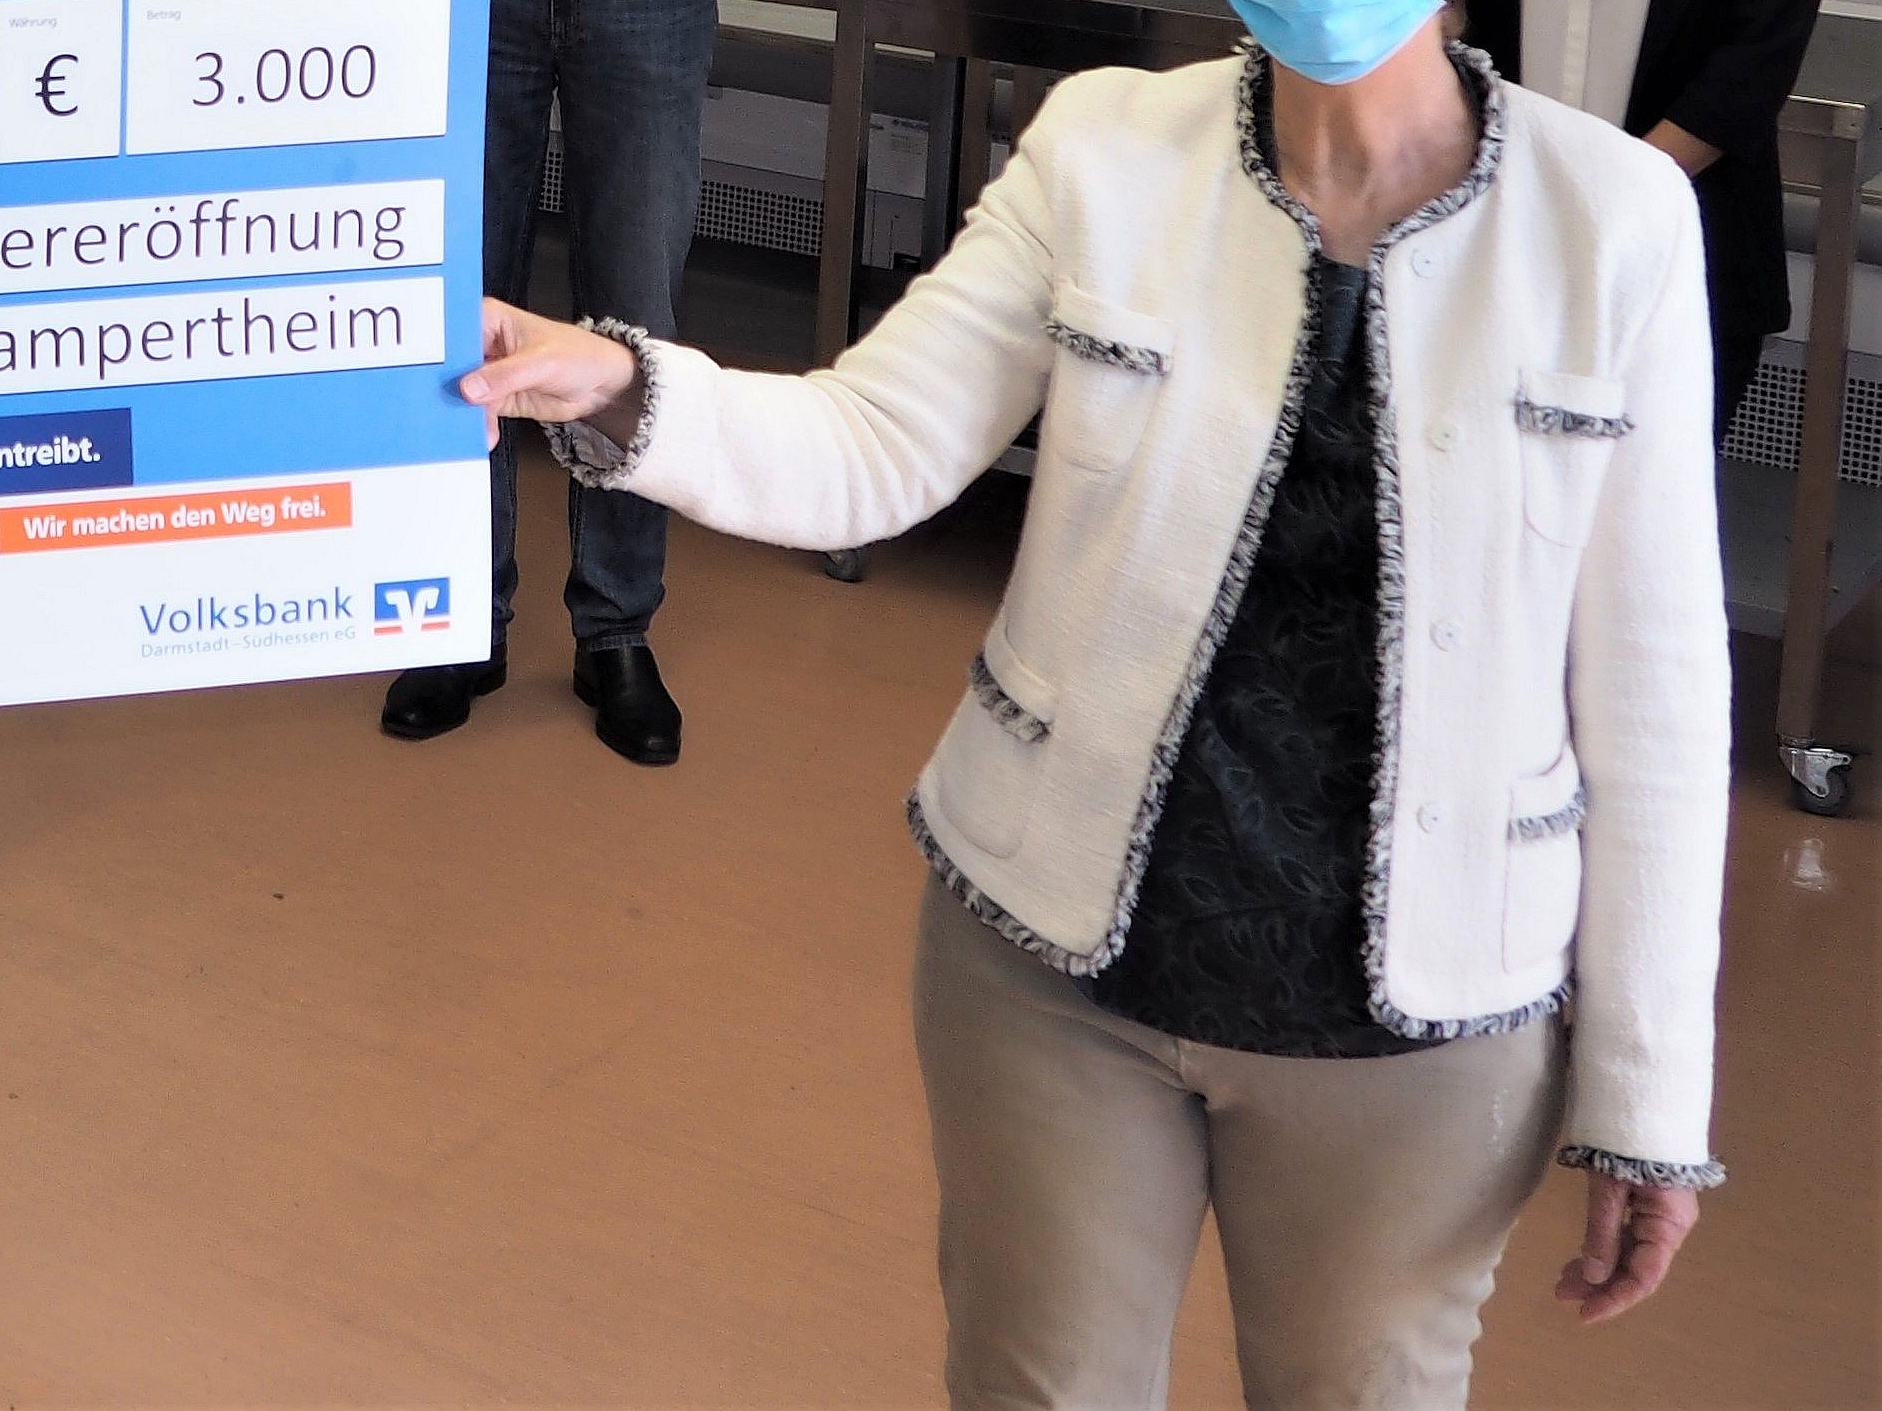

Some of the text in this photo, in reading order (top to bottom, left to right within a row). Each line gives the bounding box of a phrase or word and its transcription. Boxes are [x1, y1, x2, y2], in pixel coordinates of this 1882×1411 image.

[34, 53, 79, 117] €
[192, 44, 376, 106] 3.000
[23, 494, 326, 540] Wir machen den Weg frei.
[139, 586, 354, 636] Volksbank
[334, 625, 357, 641] eG
